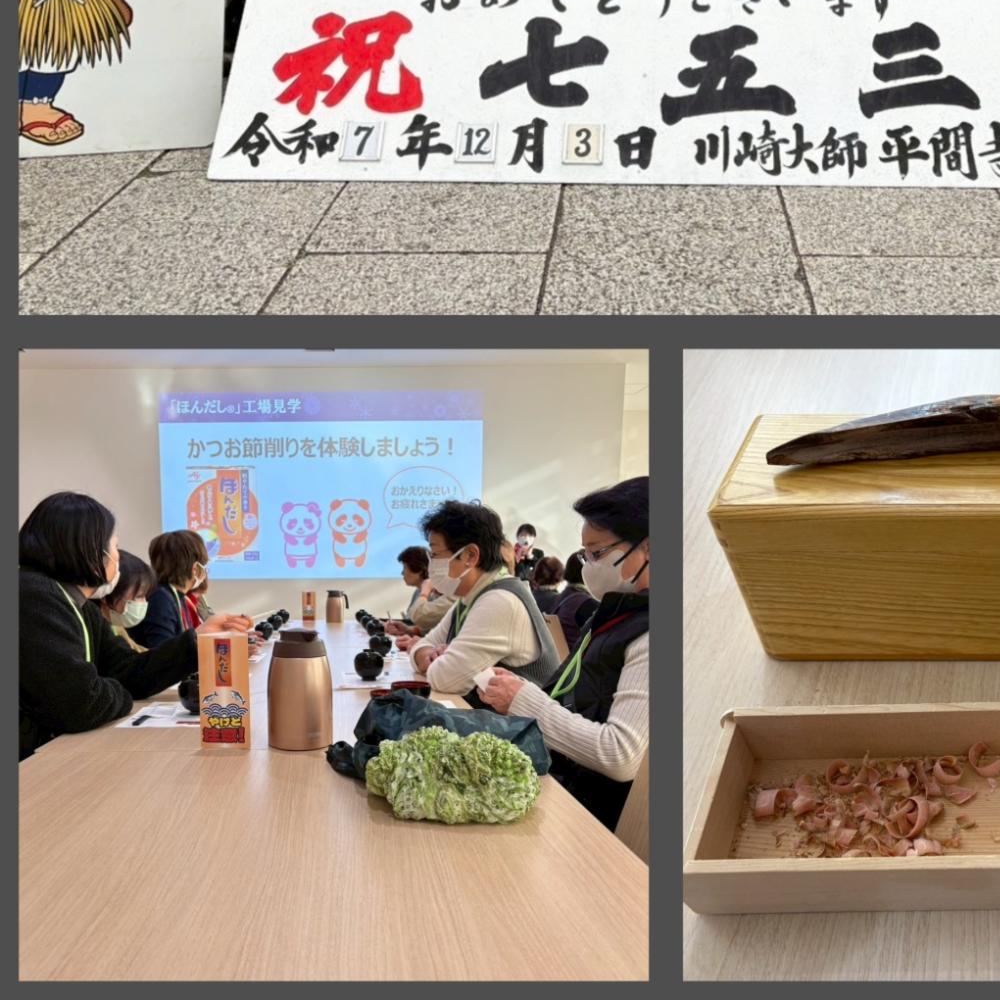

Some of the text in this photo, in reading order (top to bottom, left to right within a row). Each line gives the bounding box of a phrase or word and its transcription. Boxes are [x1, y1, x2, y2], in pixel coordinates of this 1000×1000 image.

[187, 436, 455, 460] かつお節削りを体験しましょう！
